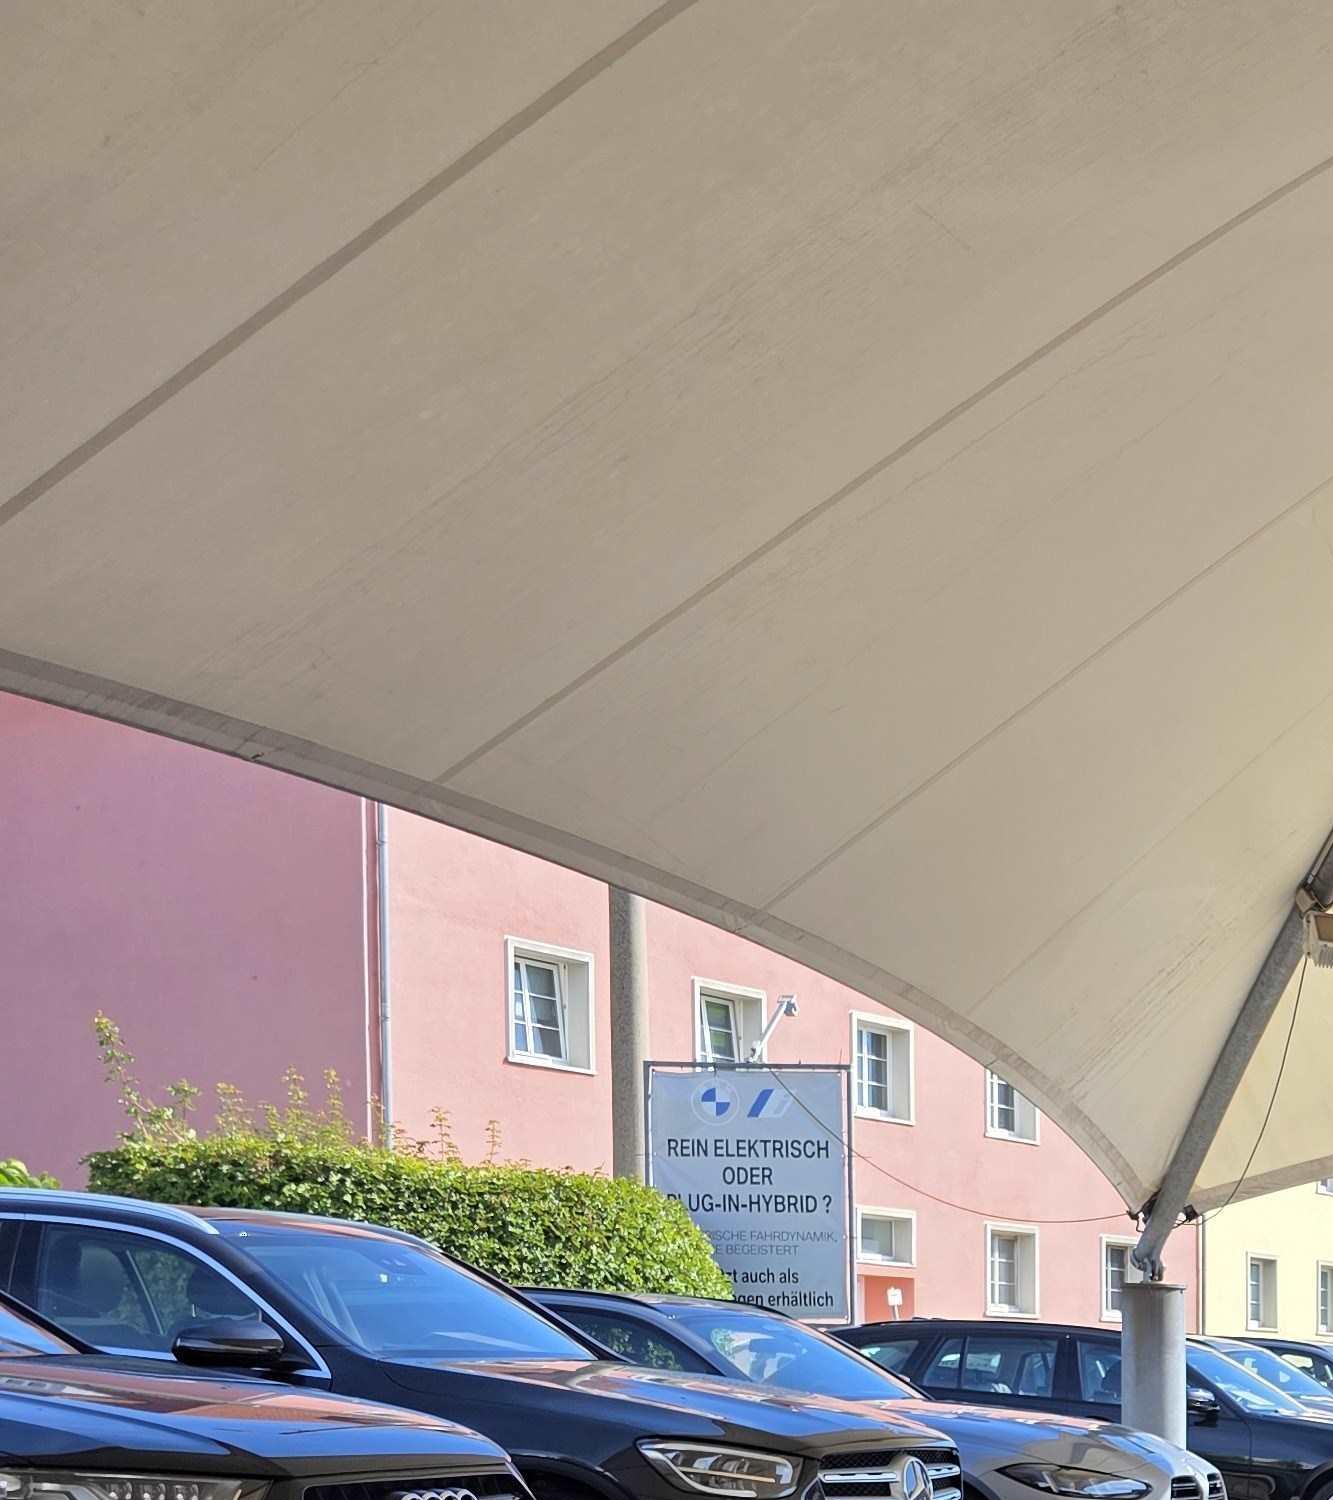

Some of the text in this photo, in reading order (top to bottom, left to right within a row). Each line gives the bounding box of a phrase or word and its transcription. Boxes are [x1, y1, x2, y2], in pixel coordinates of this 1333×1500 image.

[667, 1138, 830, 1158] REIN ELEKTRISCH
[722, 1166, 773, 1185] ODER
[666, 1194, 832, 1213] UG-IN-HYBRID ?
[750, 1230, 838, 1242] FAHRDYNAMIK,
[726, 1244, 799, 1256] BEGEISTERT
[741, 1268, 775, 1284] auch
[779, 1267, 799, 1284] als
[768, 1291, 834, 1307] erhältlich
